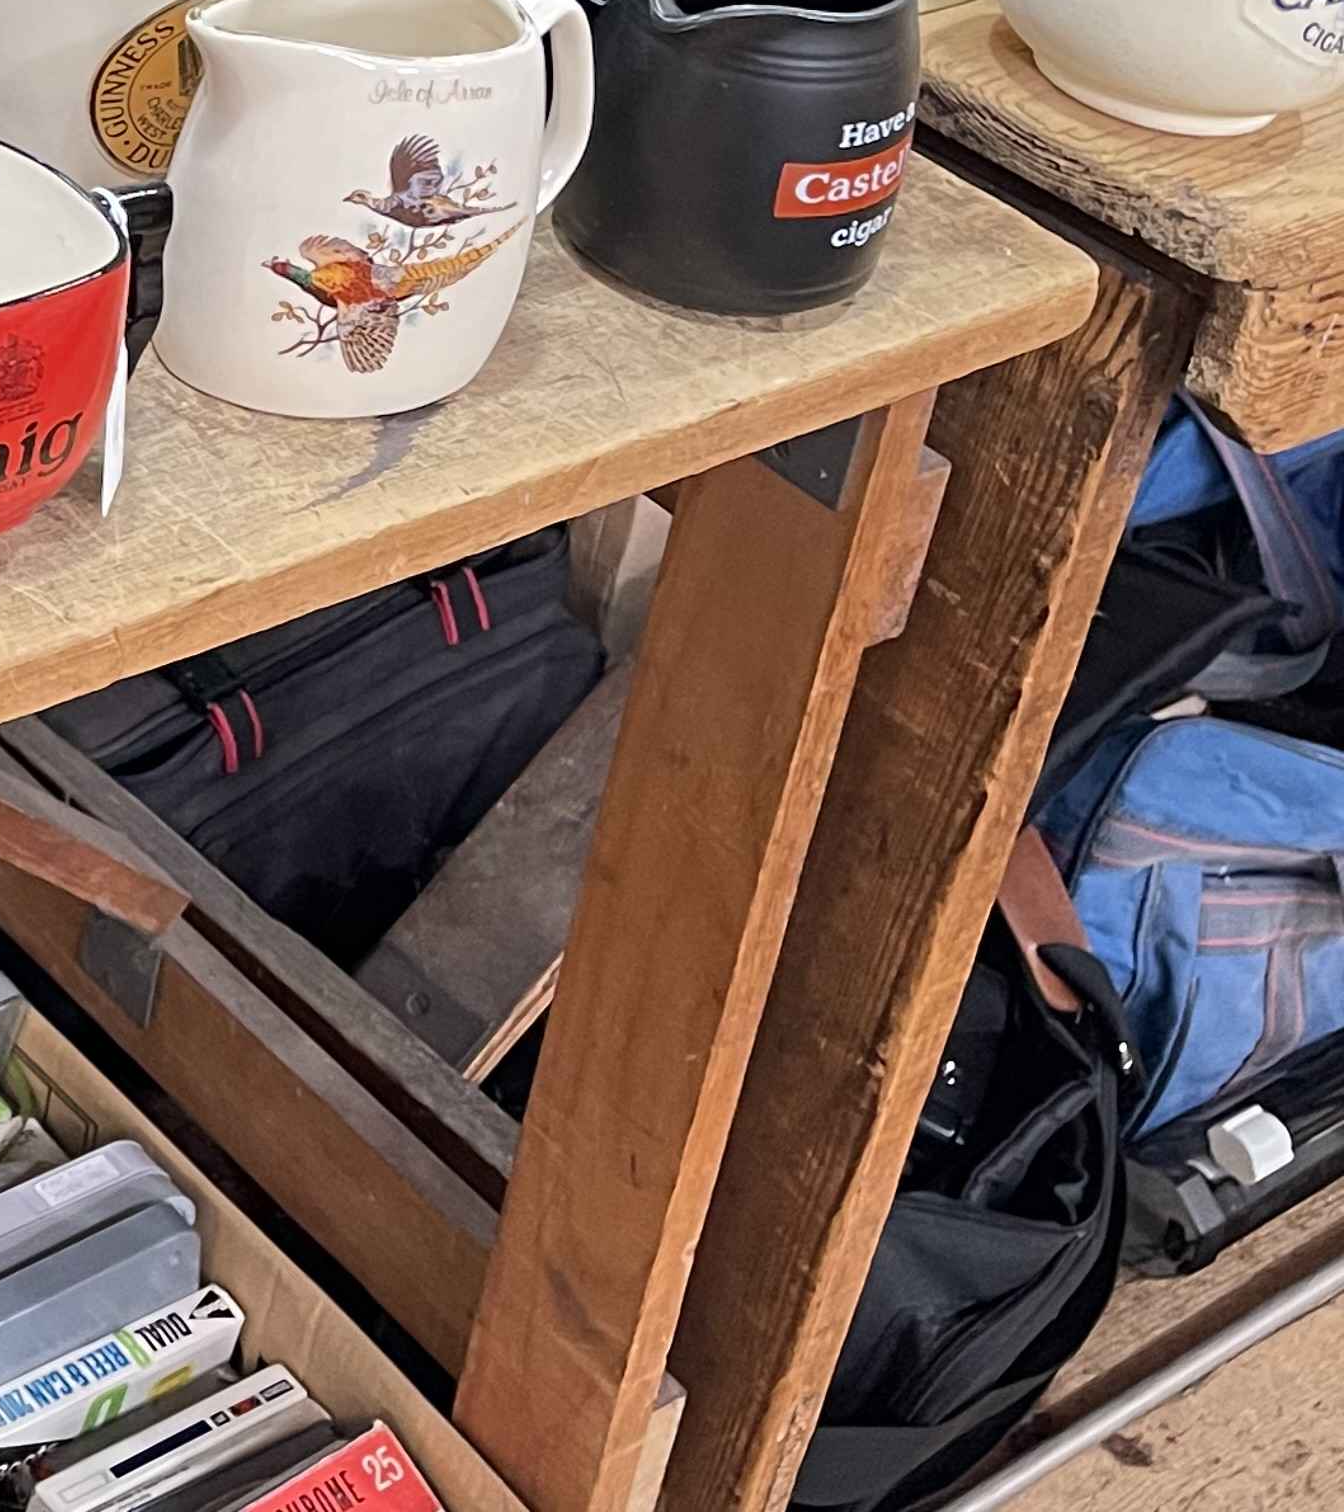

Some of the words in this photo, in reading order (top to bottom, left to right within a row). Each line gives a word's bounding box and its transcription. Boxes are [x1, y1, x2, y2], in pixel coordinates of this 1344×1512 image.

[99, 19, 176, 139] GUINNESS
[416, 79, 434, 109] of
[147, 95, 185, 131] CHARLE
[838, 110, 906, 149] Have
[134, 1311, 193, 1352] DUAL
[78, 1340, 132, 1381] REEL
[23, 1369, 76, 1411] CAN
[361, 1445, 405, 1493] 25
